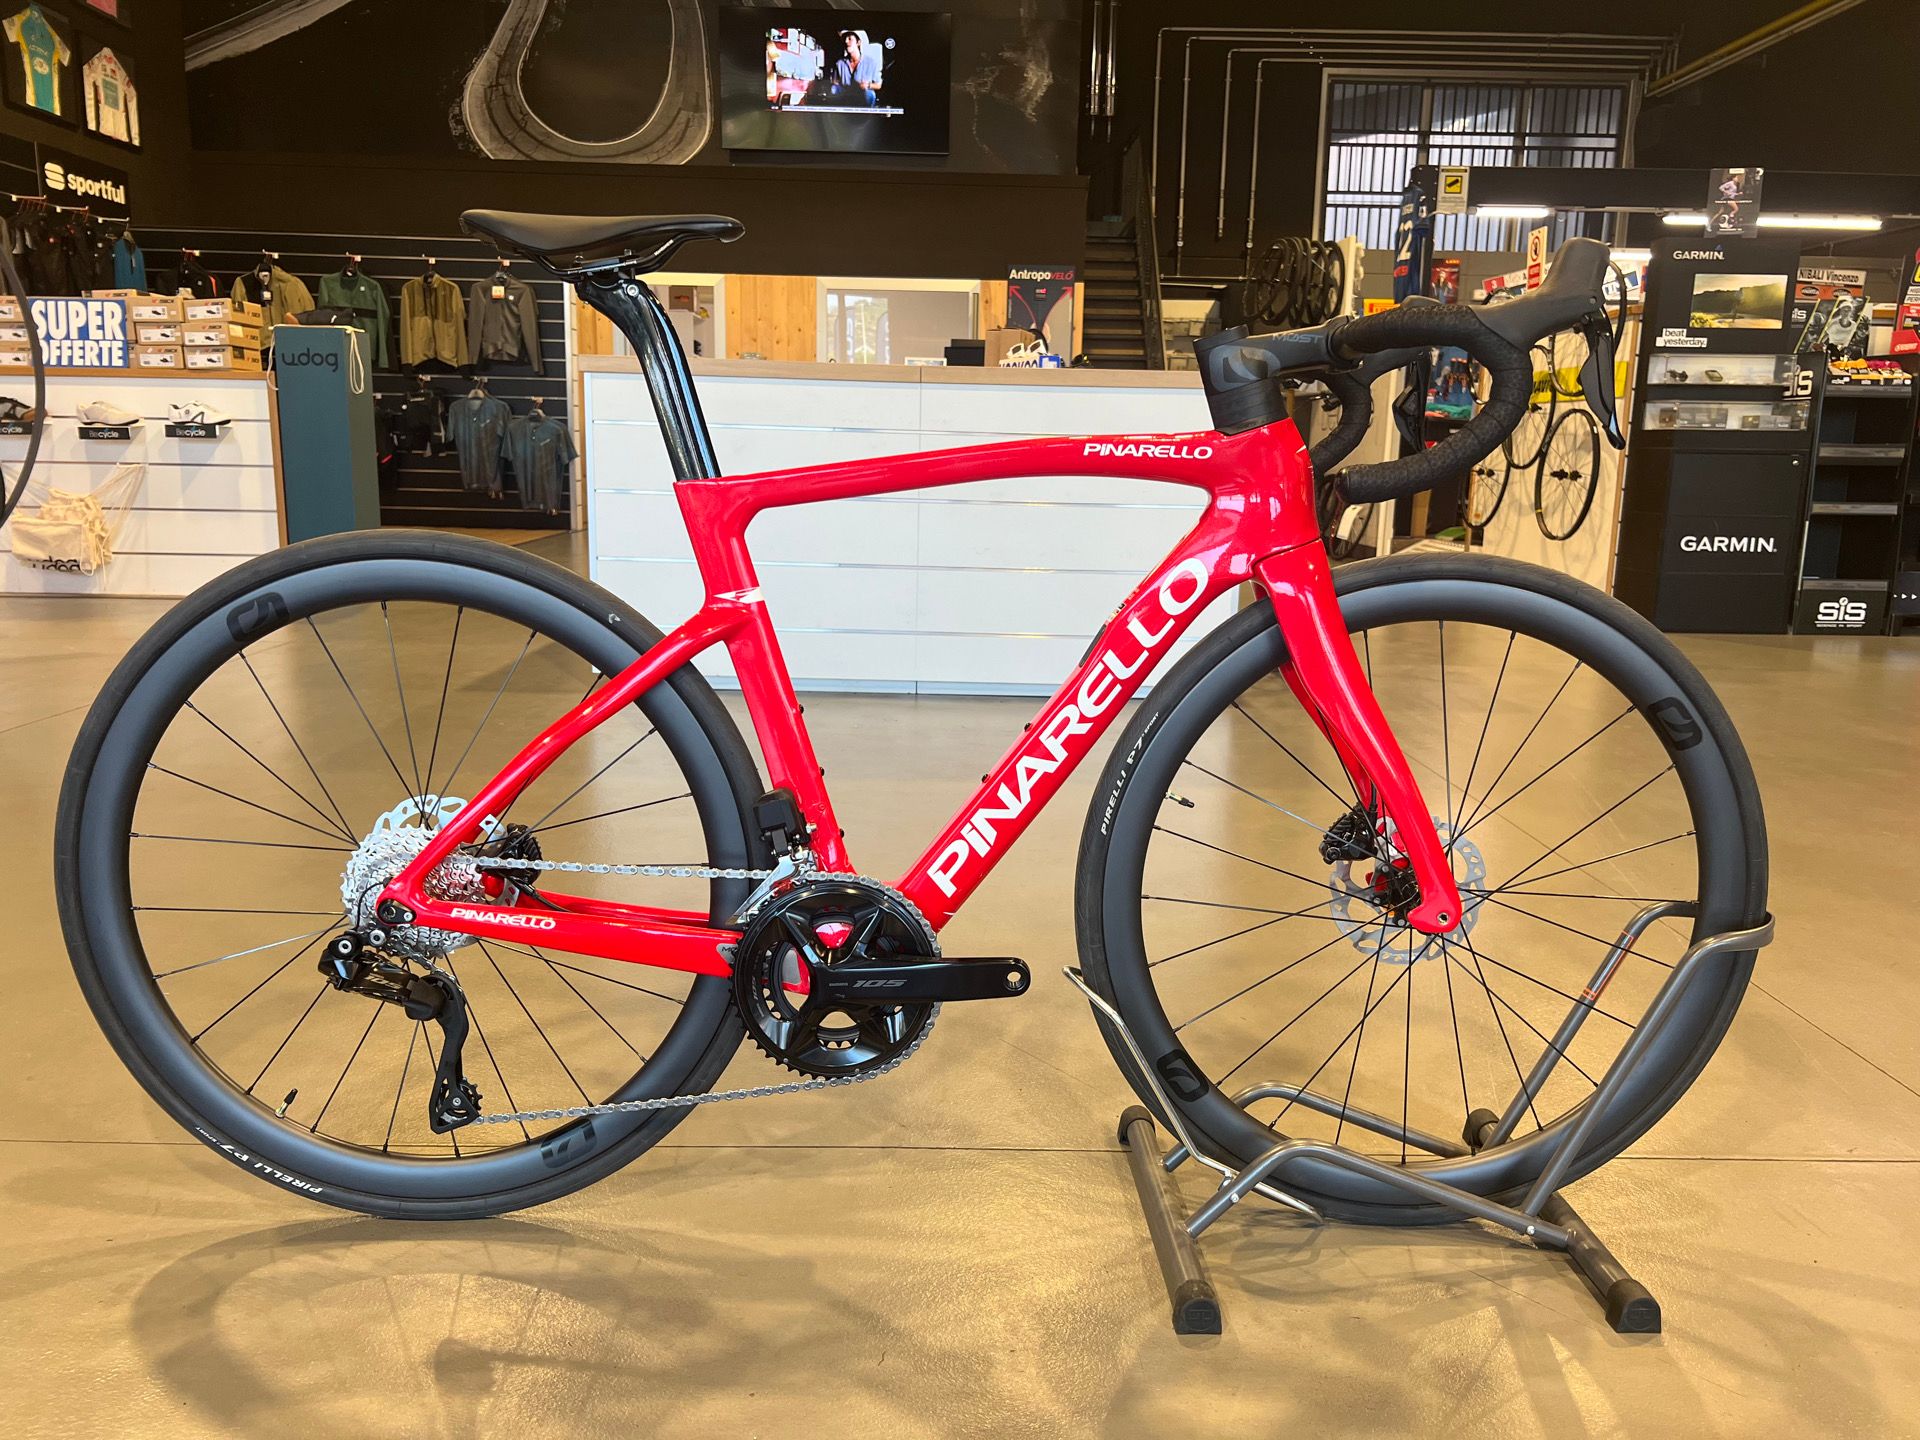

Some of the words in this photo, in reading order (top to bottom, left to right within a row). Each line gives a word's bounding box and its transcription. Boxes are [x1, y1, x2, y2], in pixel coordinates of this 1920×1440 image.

[67, 173, 125, 204] sportful
[1673, 250, 1723, 260] GARMIN
[1799, 269, 1825, 281] NIBALI
[1826, 271, 1859, 283] Vincenzo
[31, 299, 125, 340] SUPER
[1664, 329, 1685, 338] beat
[281, 347, 339, 373] udog
[1083, 442, 1213, 460] PINARELLO
[1680, 535, 1774, 552] GARMIN
[1817, 596, 1868, 621] SiS
[927, 557, 1209, 898] PINARELLO
[1100, 769, 1127, 836] PIRELLI
[450, 907, 557, 930] PINARELLO
[852, 979, 908, 988] 105
[253, 1162, 324, 1194] PIRELLI
